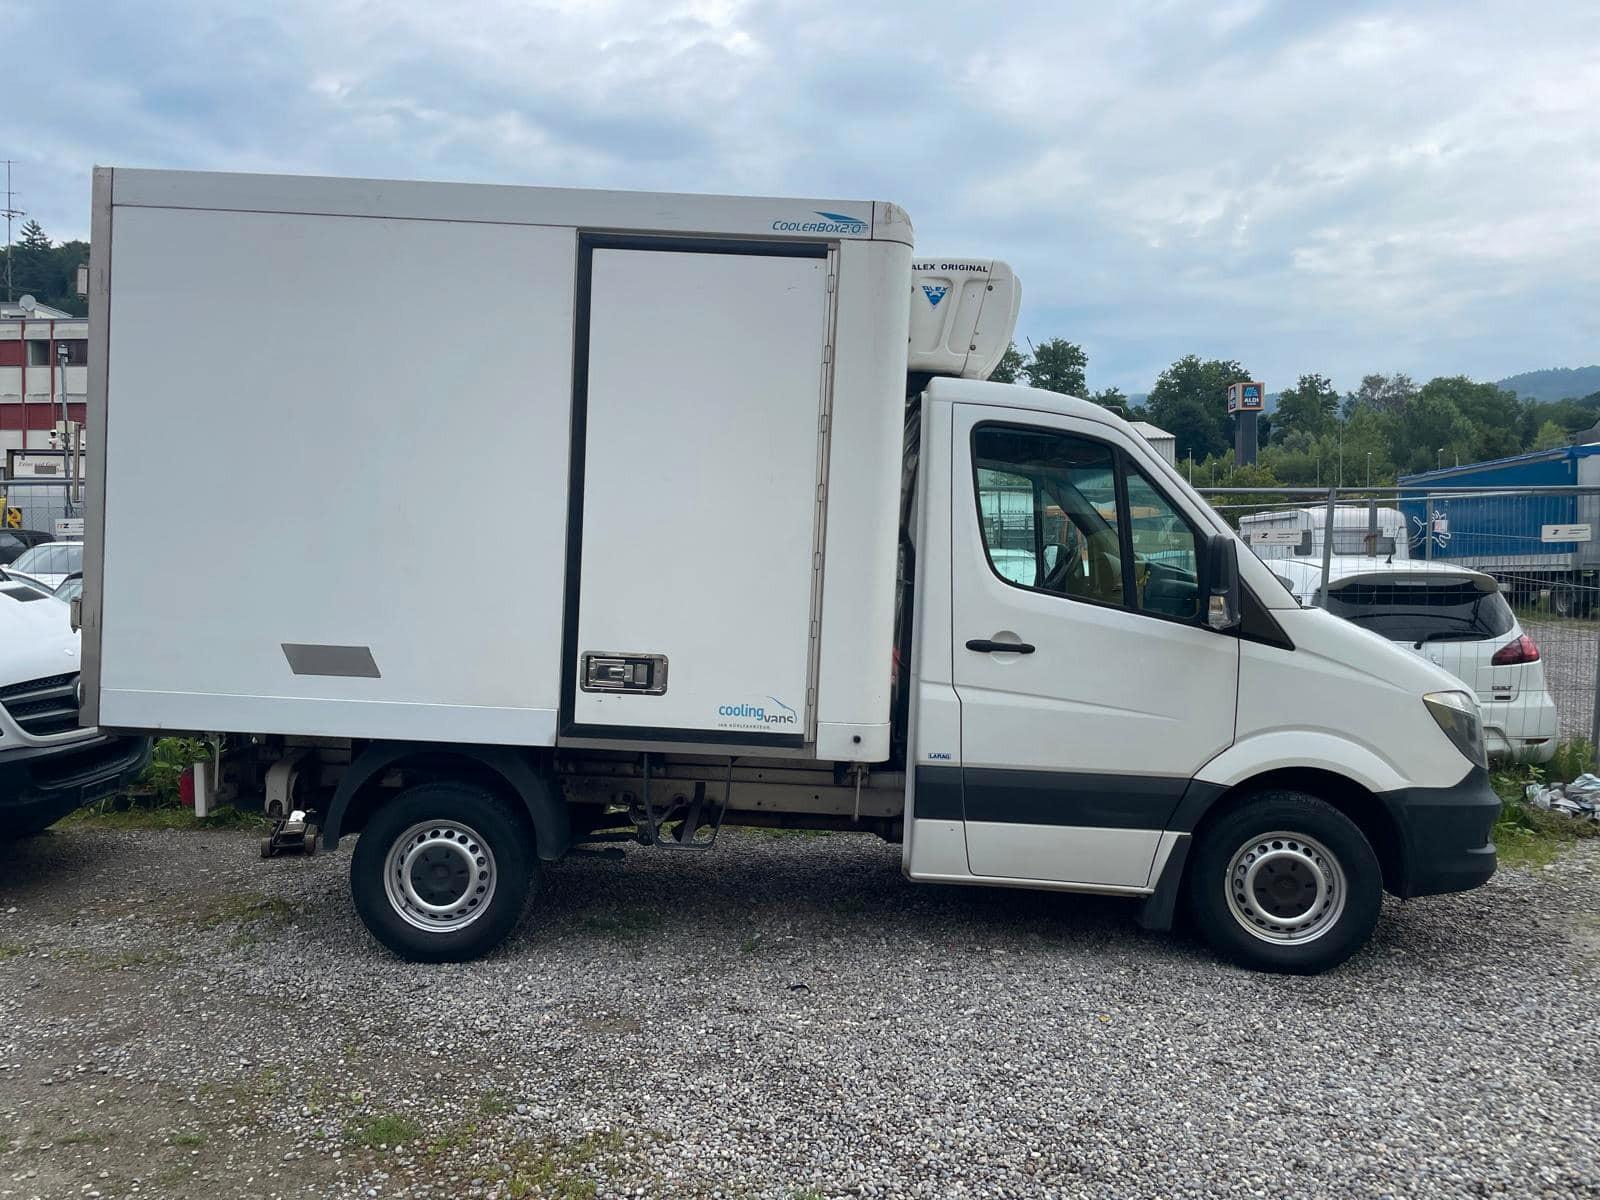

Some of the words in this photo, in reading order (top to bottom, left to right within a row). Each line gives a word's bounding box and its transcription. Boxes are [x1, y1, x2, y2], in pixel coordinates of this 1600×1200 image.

[940, 263, 989, 273] ORIGINAL
[718, 703, 764, 721] cooling
[763, 715, 795, 724] vans
